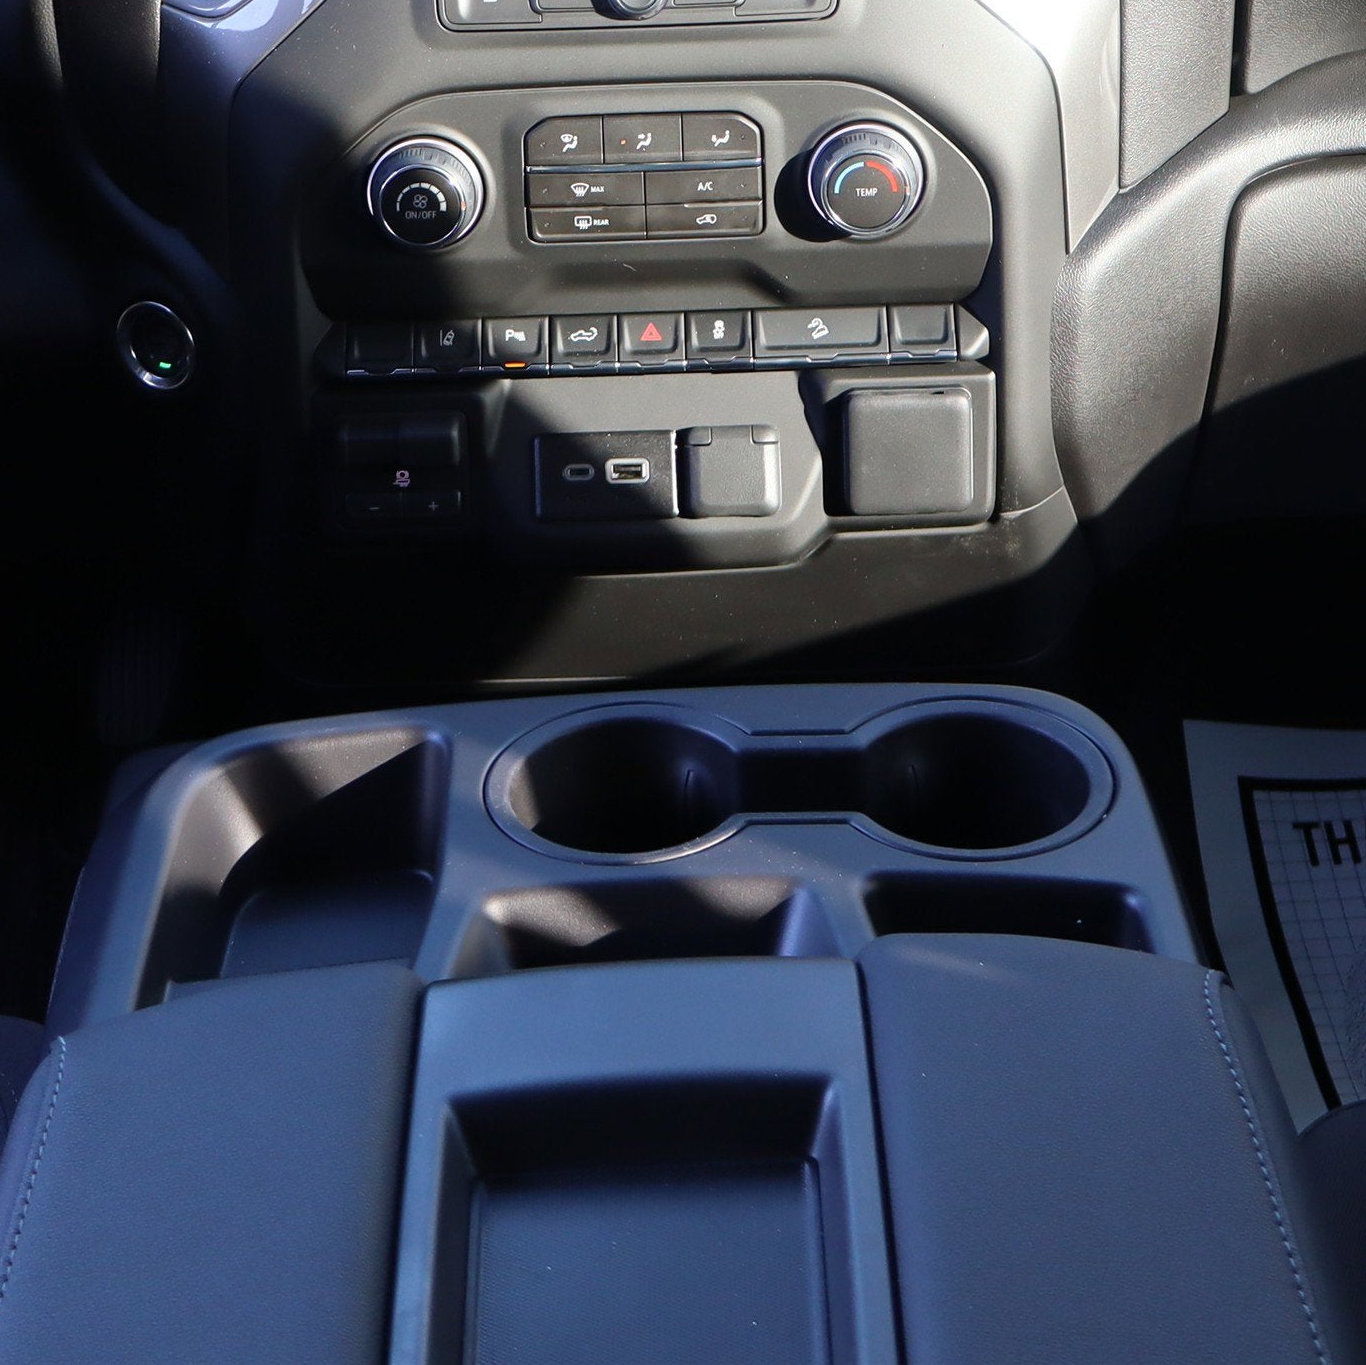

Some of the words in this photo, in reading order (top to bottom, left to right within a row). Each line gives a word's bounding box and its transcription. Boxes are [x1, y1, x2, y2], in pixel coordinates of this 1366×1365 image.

[697, 181, 714, 191] A/C
[855, 187, 879, 197] TEMP
[404, 210, 438, 220] ON/OFF
[593, 218, 610, 226] REAR
